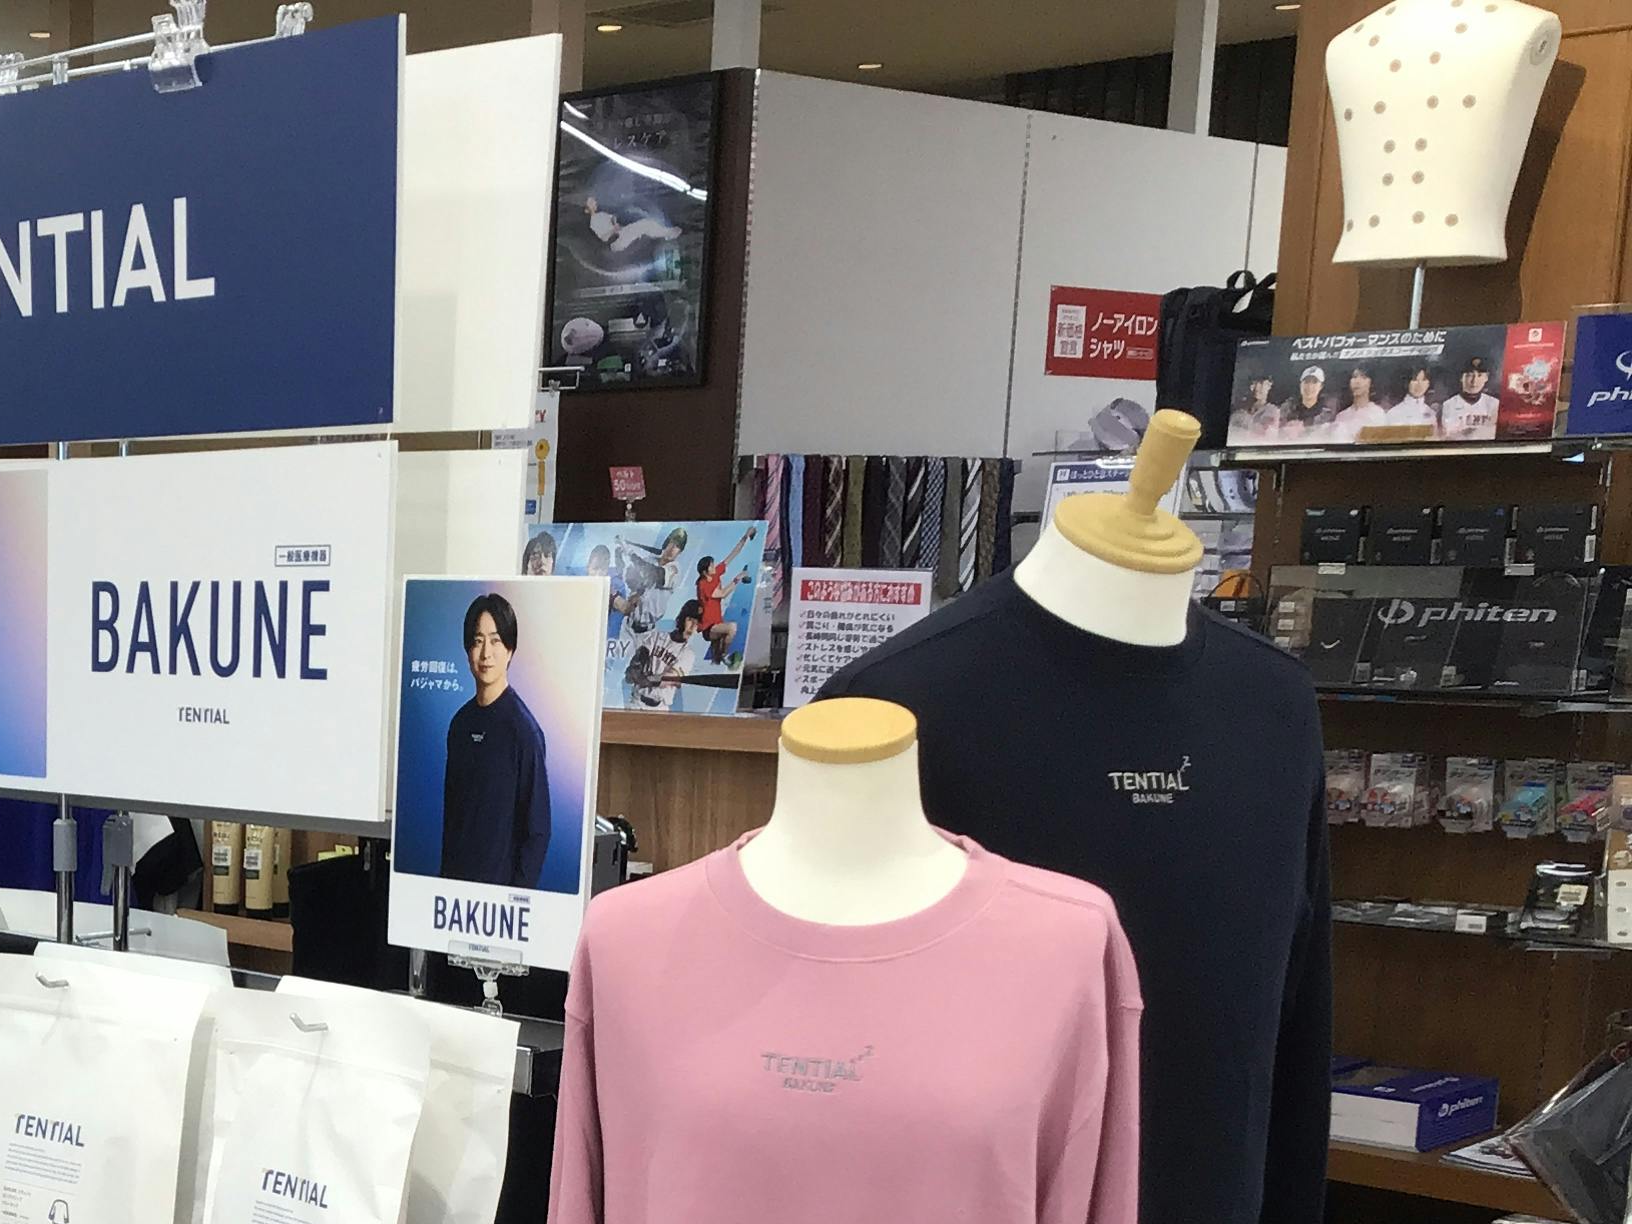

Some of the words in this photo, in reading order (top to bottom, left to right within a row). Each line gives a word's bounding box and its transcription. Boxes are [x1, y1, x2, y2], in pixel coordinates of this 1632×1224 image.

[1091, 312, 1158, 336] ノーアイロン
[1089, 337, 1125, 360] シャツ
[1291, 330, 1447, 350] ベストパフォーマンスのために
[1418, 602, 1558, 628] phiten
[91, 579, 330, 681] BAKUNE
[178, 707, 230, 724] TENTIAL
[1108, 769, 1190, 791] TENTIAL
[434, 894, 531, 942] BAKUNE
[761, 1051, 863, 1082] TENTIAL
[14, 1113, 85, 1148] TENTIAL
[261, 1168, 329, 1210] TENTIAL
